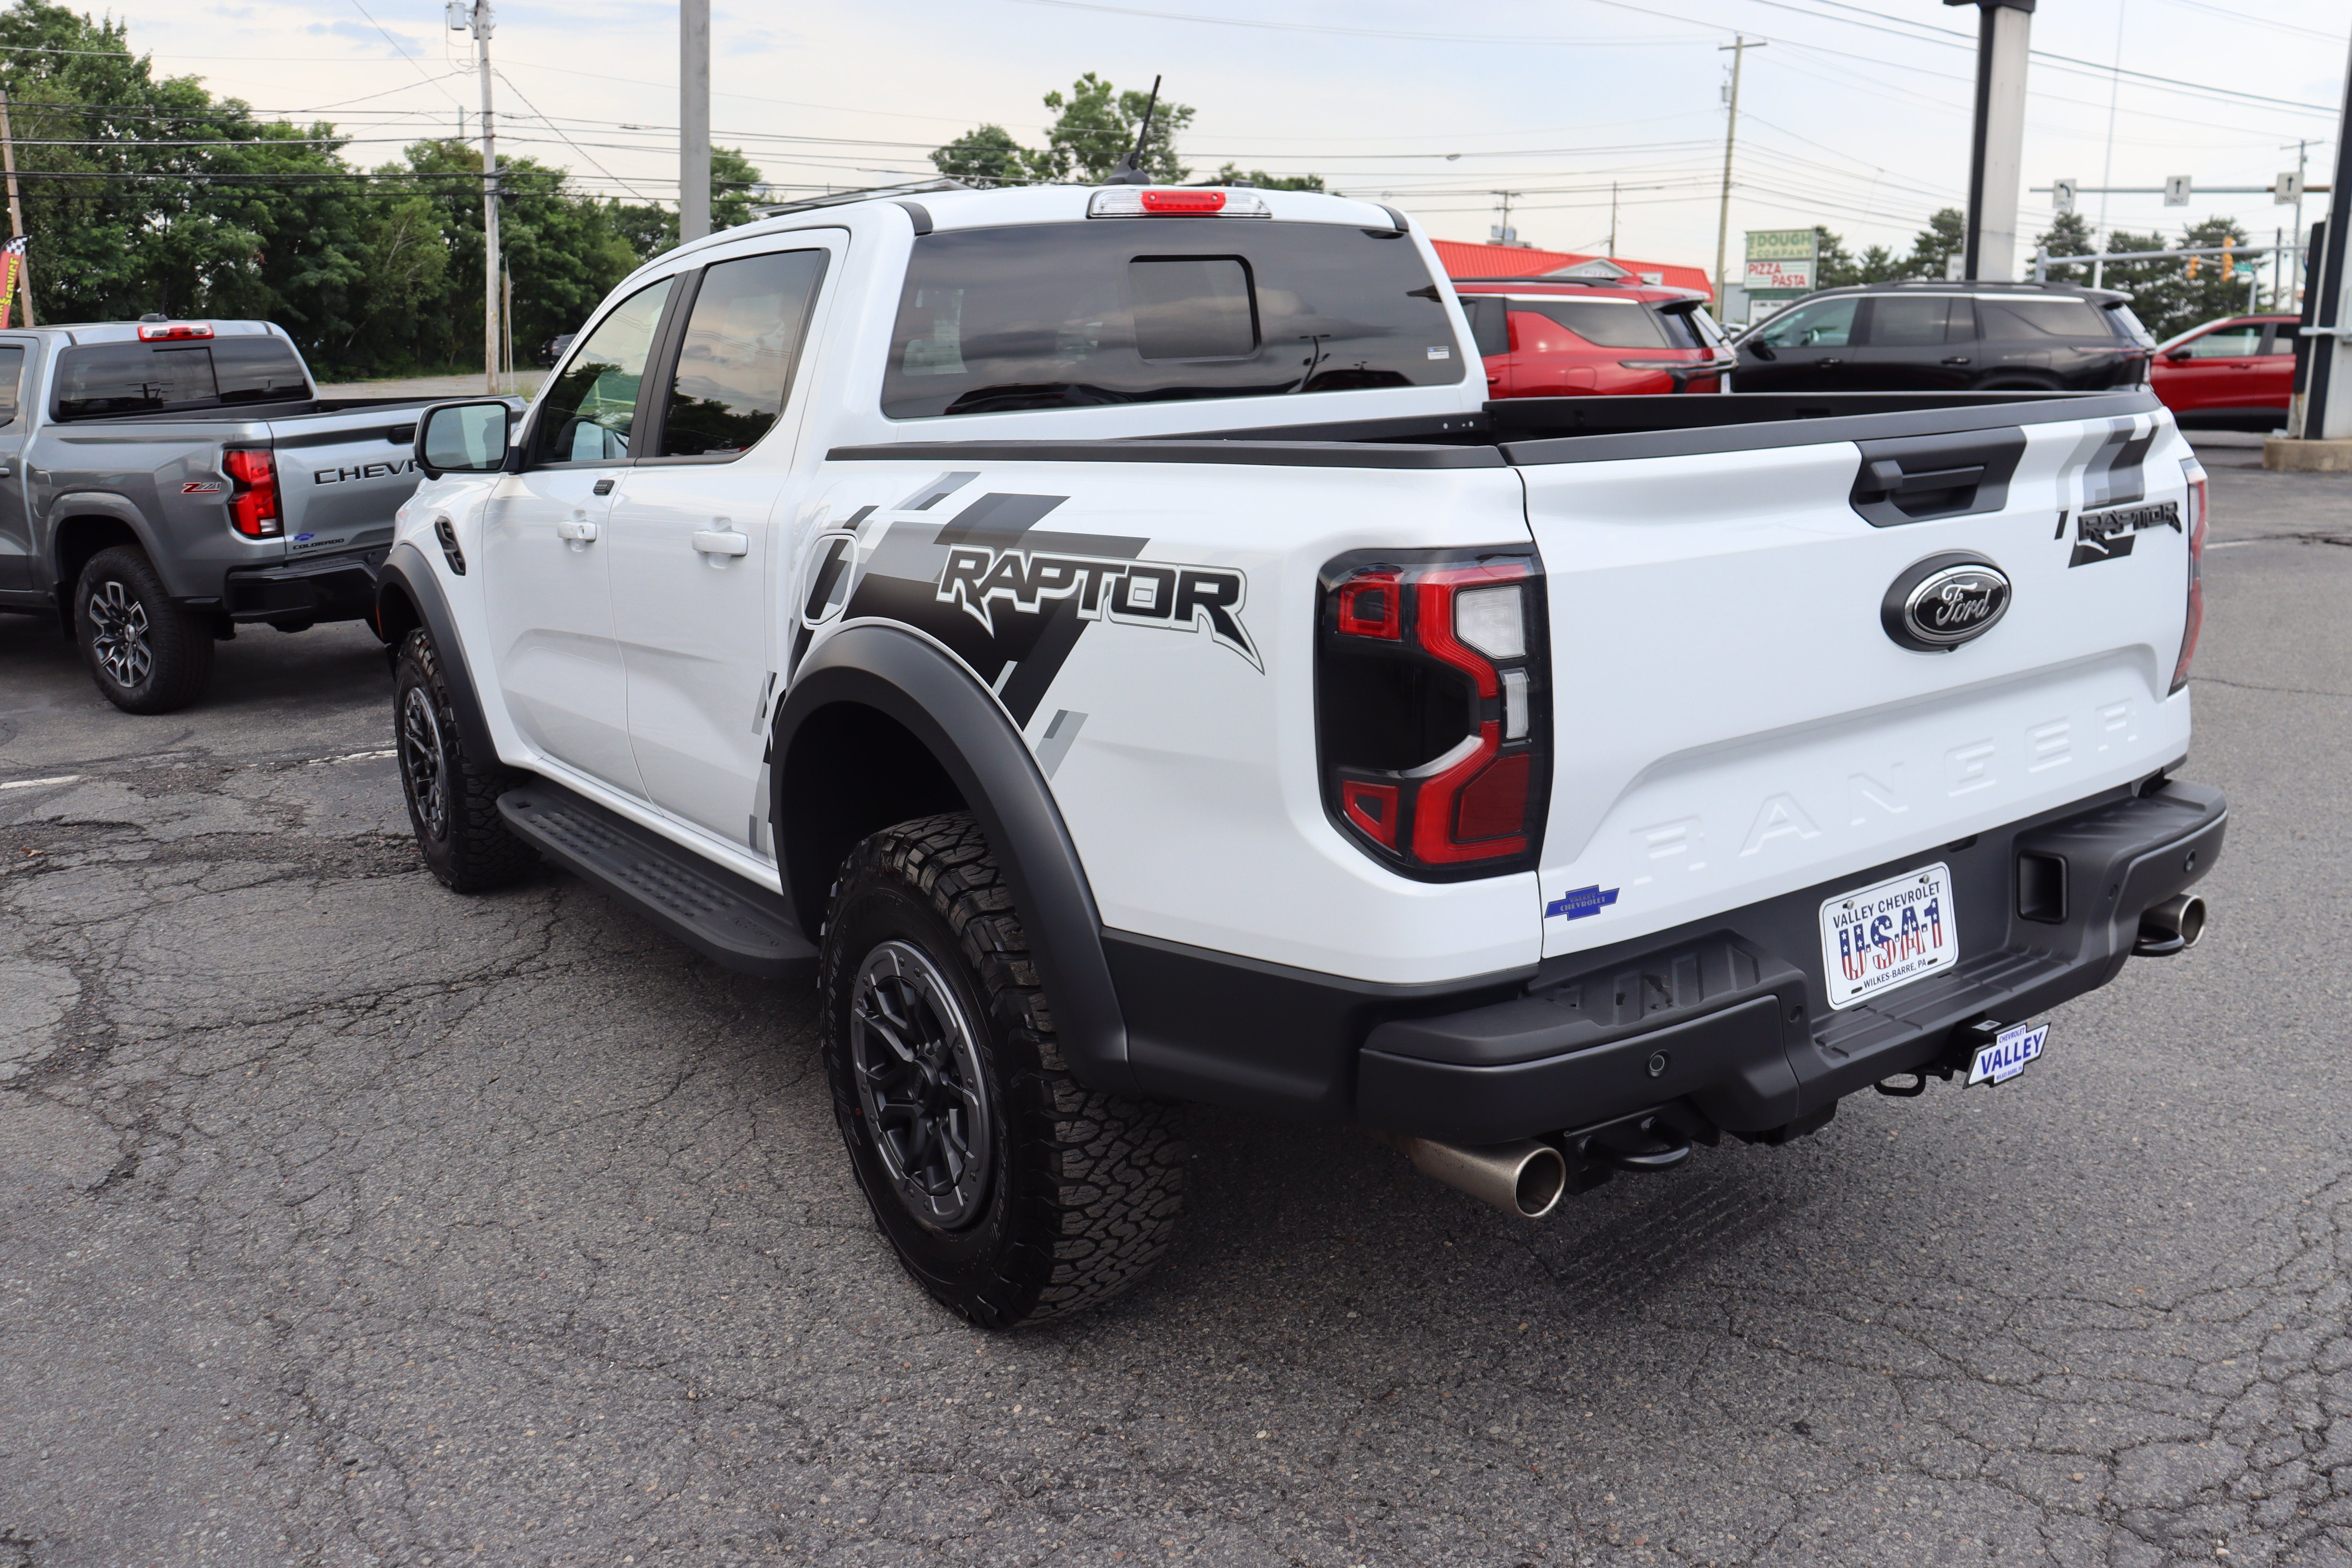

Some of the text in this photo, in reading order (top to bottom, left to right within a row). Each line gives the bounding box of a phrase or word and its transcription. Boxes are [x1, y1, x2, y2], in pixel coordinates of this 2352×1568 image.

[1757, 233, 1812, 247] DOUGH
[1757, 249, 1810, 257] COMPANY
[1748, 262, 1781, 274] PIZZA
[4, 256, 19, 306] SERVICE
[1772, 274, 1806, 286] PASTA
[181, 482, 221, 494] Z71
[2078, 499, 2182, 551] RAPTOR
[293, 538, 344, 550] COLORADO
[935, 543, 1265, 676] RAPTOR
[1936, 582, 1991, 626] Ford
[1629, 698, 2138, 884] RANGER
[1560, 896, 1606, 911] CHEVROLET
[1833, 881, 1940, 929] VALLEY CHEVROLET
[1863, 959, 1927, 989] WILKES-BARRE, PA
[1999, 1027, 2026, 1043] CHEVROLET
[1981, 1031, 2043, 1075] VALLEY
